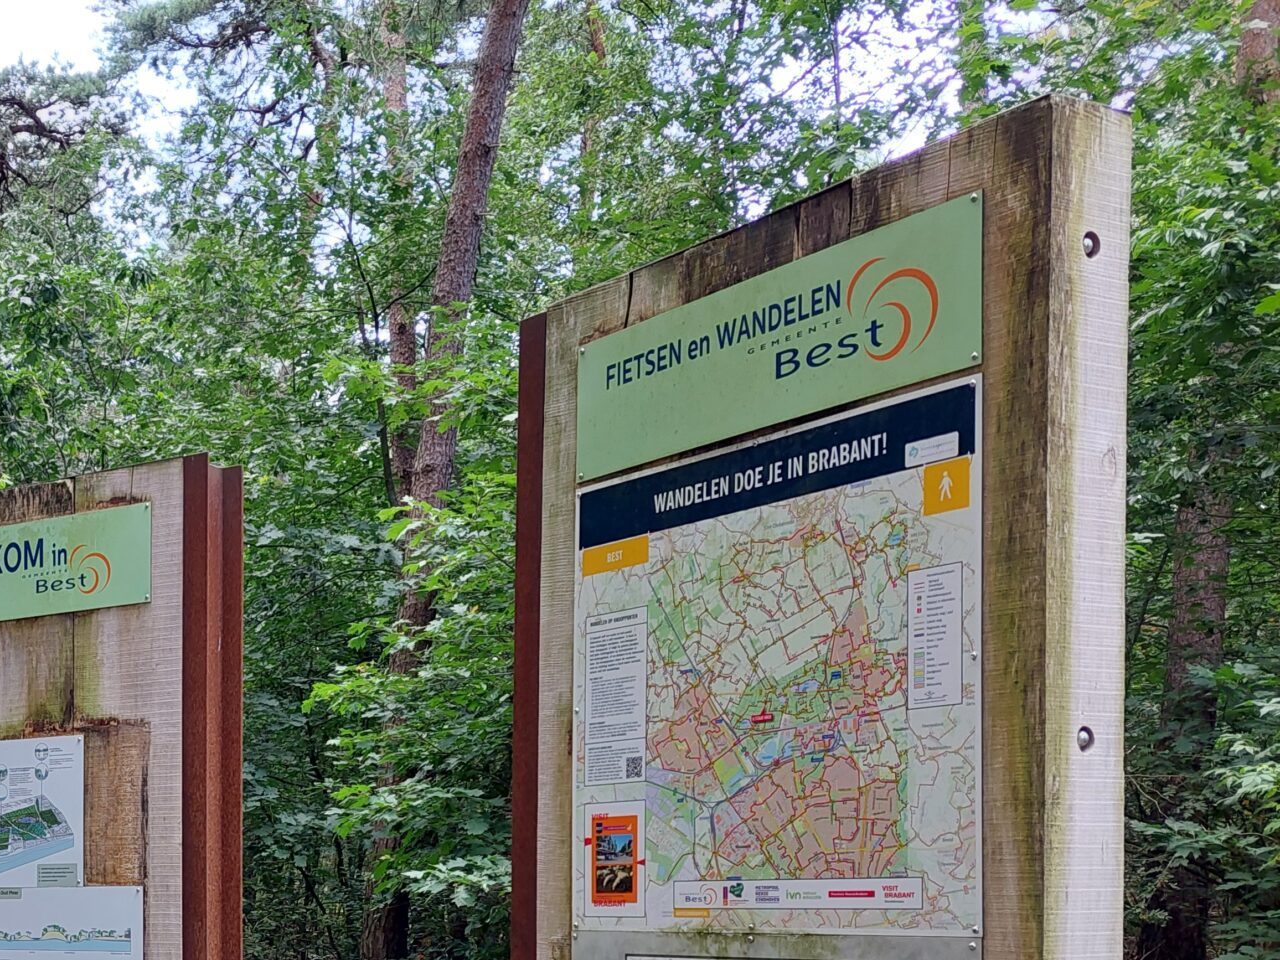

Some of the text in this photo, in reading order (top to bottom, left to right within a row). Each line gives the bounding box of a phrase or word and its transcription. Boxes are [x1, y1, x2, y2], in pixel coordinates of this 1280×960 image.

[606, 279, 842, 390] FIETSEN en WANDELEN
[747, 316, 843, 355] GEMEENTE
[775, 319, 884, 379] Best
[653, 473, 729, 514] WANDELEN
[734, 466, 764, 497] DOE
[767, 461, 783, 487] JE
[787, 456, 803, 480] IN
[808, 433, 887, 475] BRABANT!
[52, 543, 68, 566] in
[606, 550, 624, 563] BEST
[36, 573, 87, 594] Best
[685, 895, 708, 903] Best
